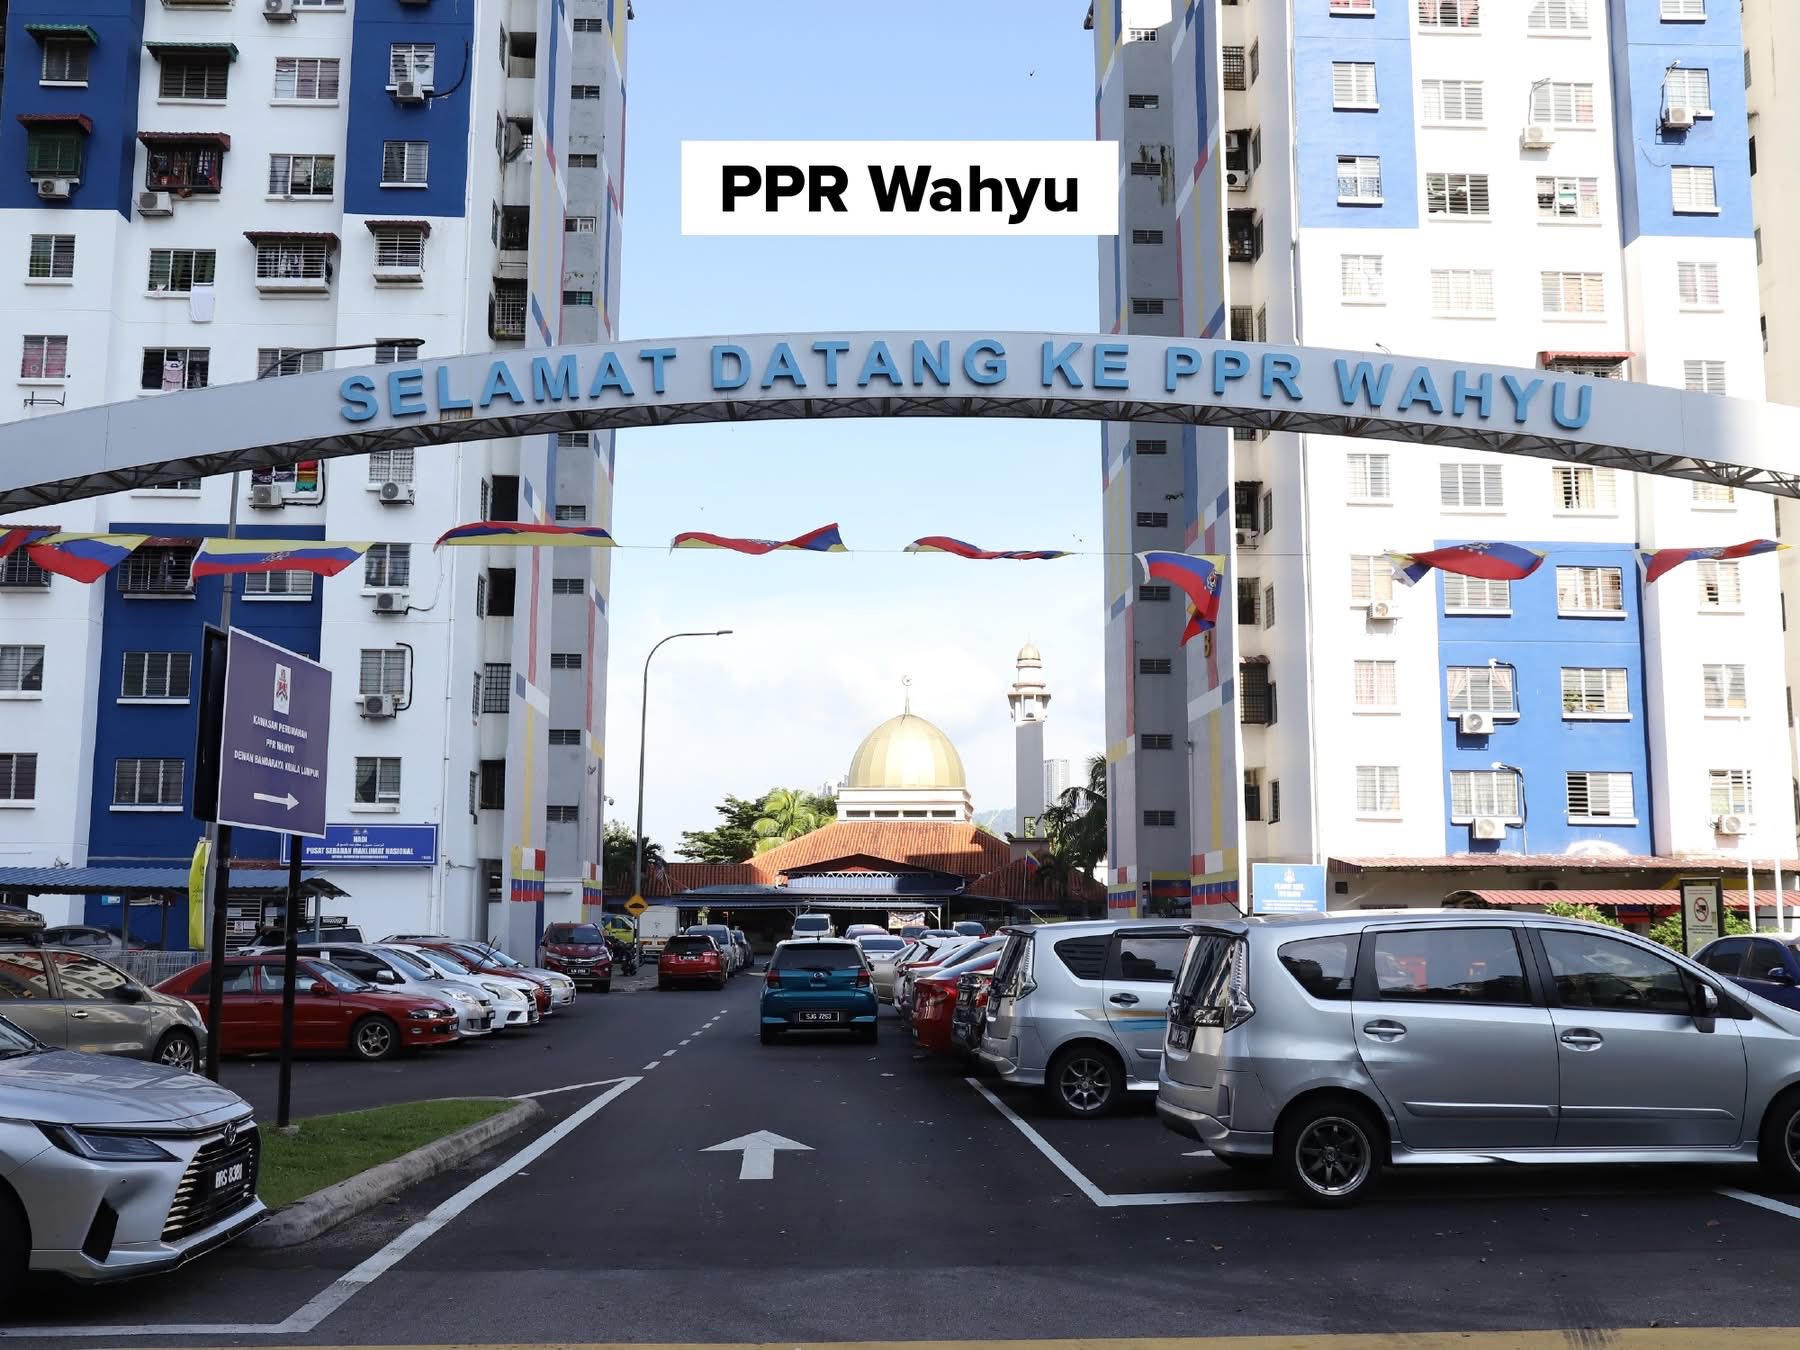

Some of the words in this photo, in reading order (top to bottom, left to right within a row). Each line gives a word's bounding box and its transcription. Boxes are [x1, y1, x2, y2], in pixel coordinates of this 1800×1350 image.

[339, 347, 677, 424] SELAMAT
[710, 338, 1008, 392] DATANG
[1040, 341, 1130, 389] KE
[1164, 346, 1303, 399] PPR
[1333, 359, 1593, 430] WAHYU
[253, 714, 278, 731] KAWASAN
[278, 722, 308, 740] PERUMAHAN
[233, 749, 254, 764] DEWAN
[254, 754, 284, 770] BANDARAYA
[284, 761, 301, 775] KUALA
[300, 766, 320, 779] LUMPUR
[306, 847, 325, 855] PUSAT
[385, 847, 414, 855] NASIONAL
